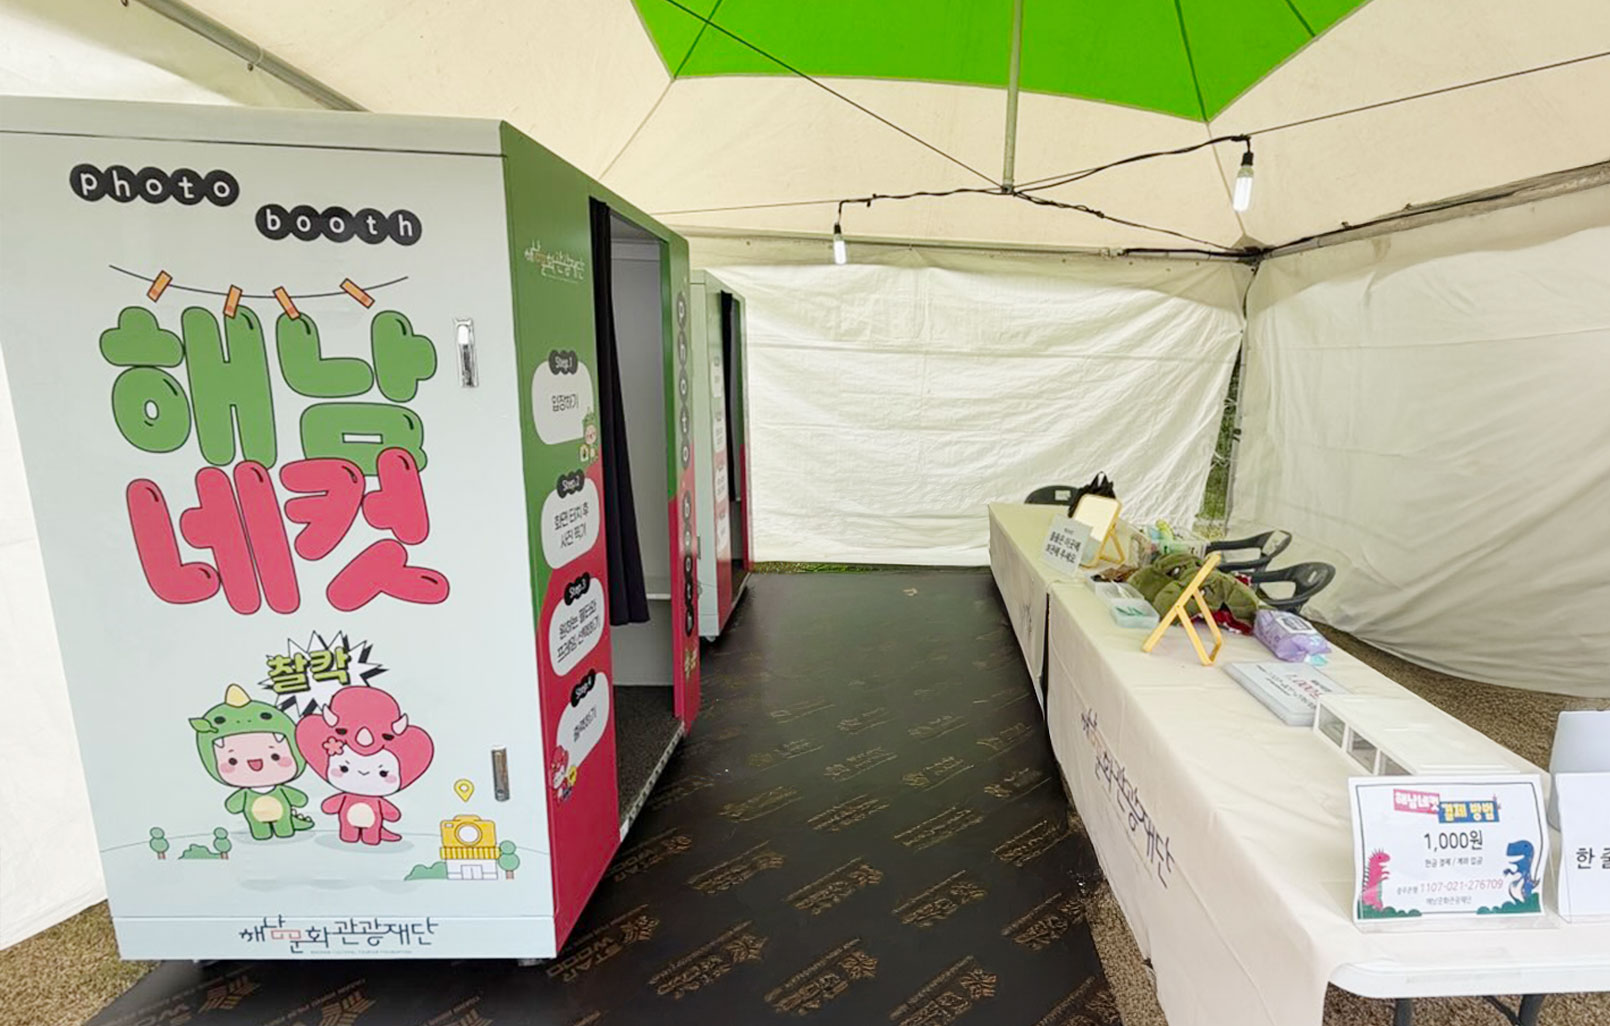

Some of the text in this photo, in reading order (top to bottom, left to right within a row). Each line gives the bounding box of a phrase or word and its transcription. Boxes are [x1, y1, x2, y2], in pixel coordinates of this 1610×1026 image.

[77, 168, 233, 201] photo
[264, 207, 414, 239] booth
[99, 305, 438, 477] 해남
[126, 447, 450, 615] 네컷
[267, 646, 352, 694] 찰칵
[1424, 830, 1483, 852] 1,000원
